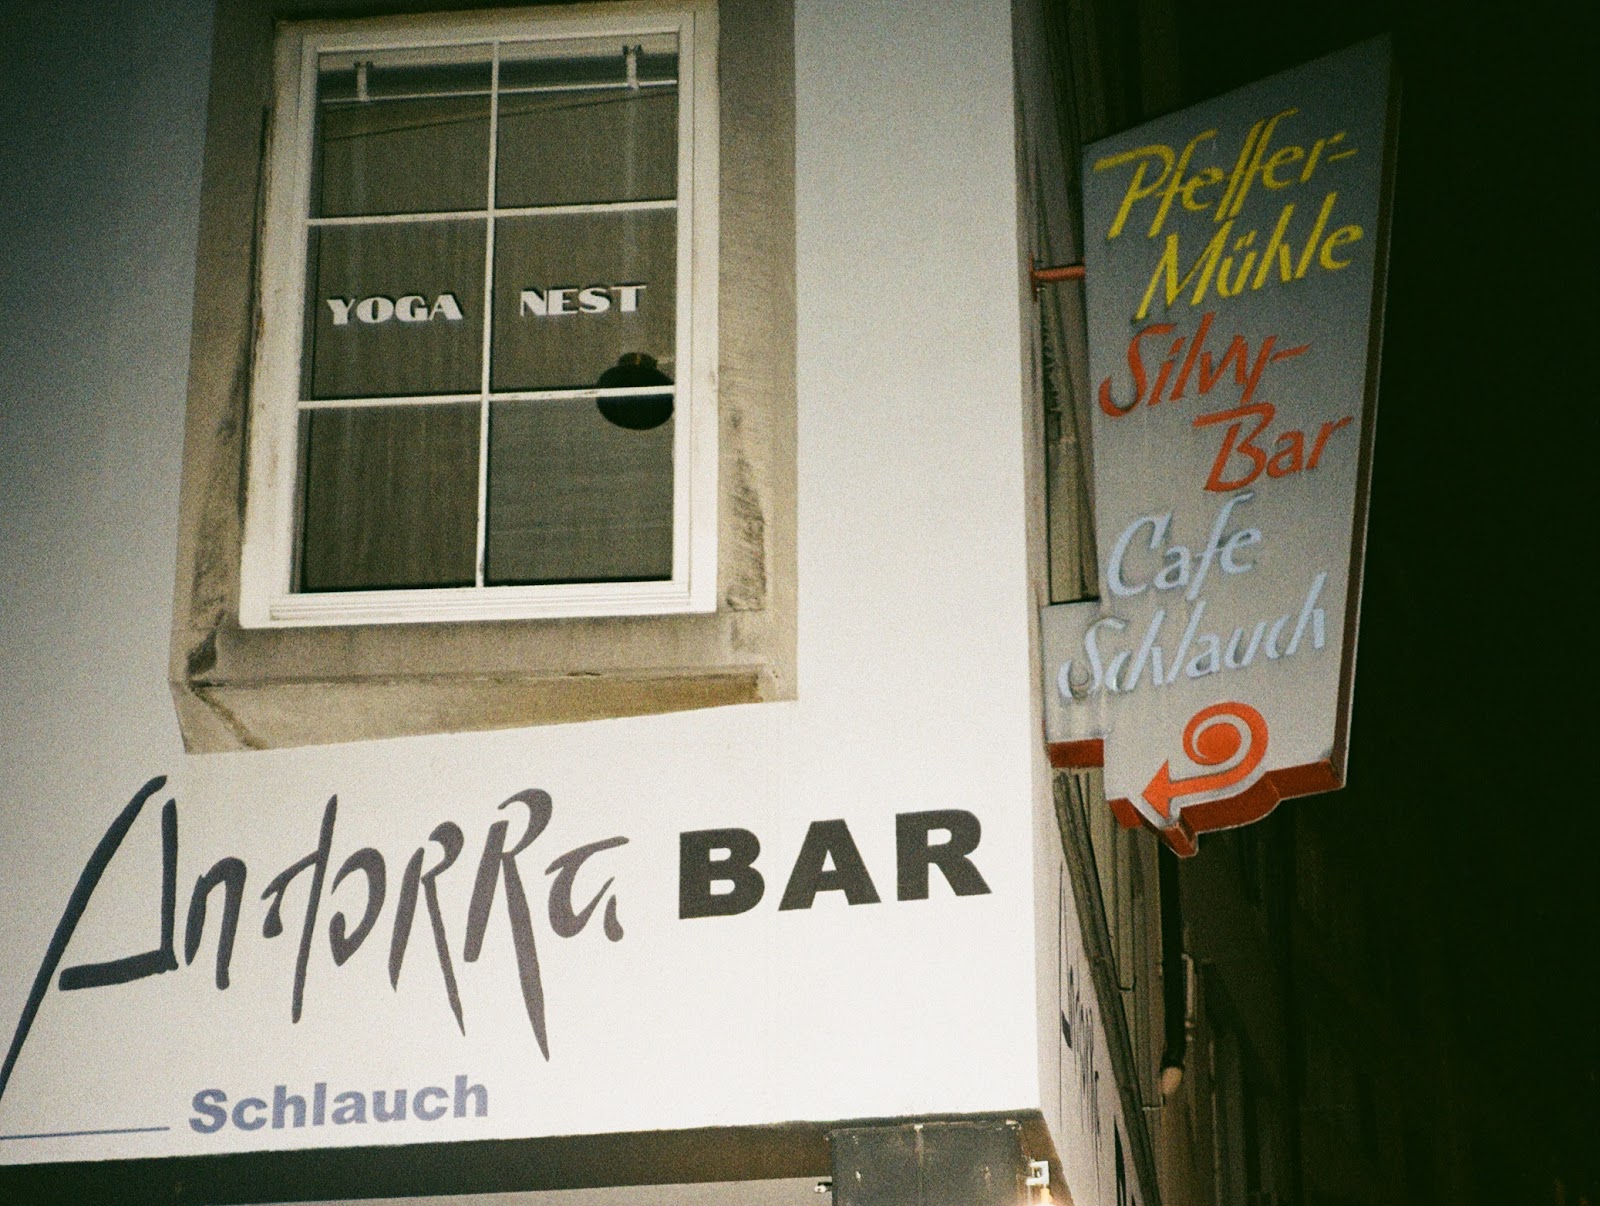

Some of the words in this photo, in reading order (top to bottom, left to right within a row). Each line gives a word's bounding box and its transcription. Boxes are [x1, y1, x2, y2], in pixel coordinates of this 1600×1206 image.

[1093, 109, 1360, 241] Pfeffer-
[327, 294, 463, 326] YOGA
[519, 284, 646, 317] NEST
[1134, 194, 1366, 322] Mühle
[1098, 314, 1310, 417] Silvy-
[1193, 403, 1352, 493] Bar
[1107, 493, 1263, 600] Cafe
[1058, 571, 1328, 700] Schlauch
[679, 809, 993, 920] BAR
[189, 1075, 489, 1135] Schlauch
